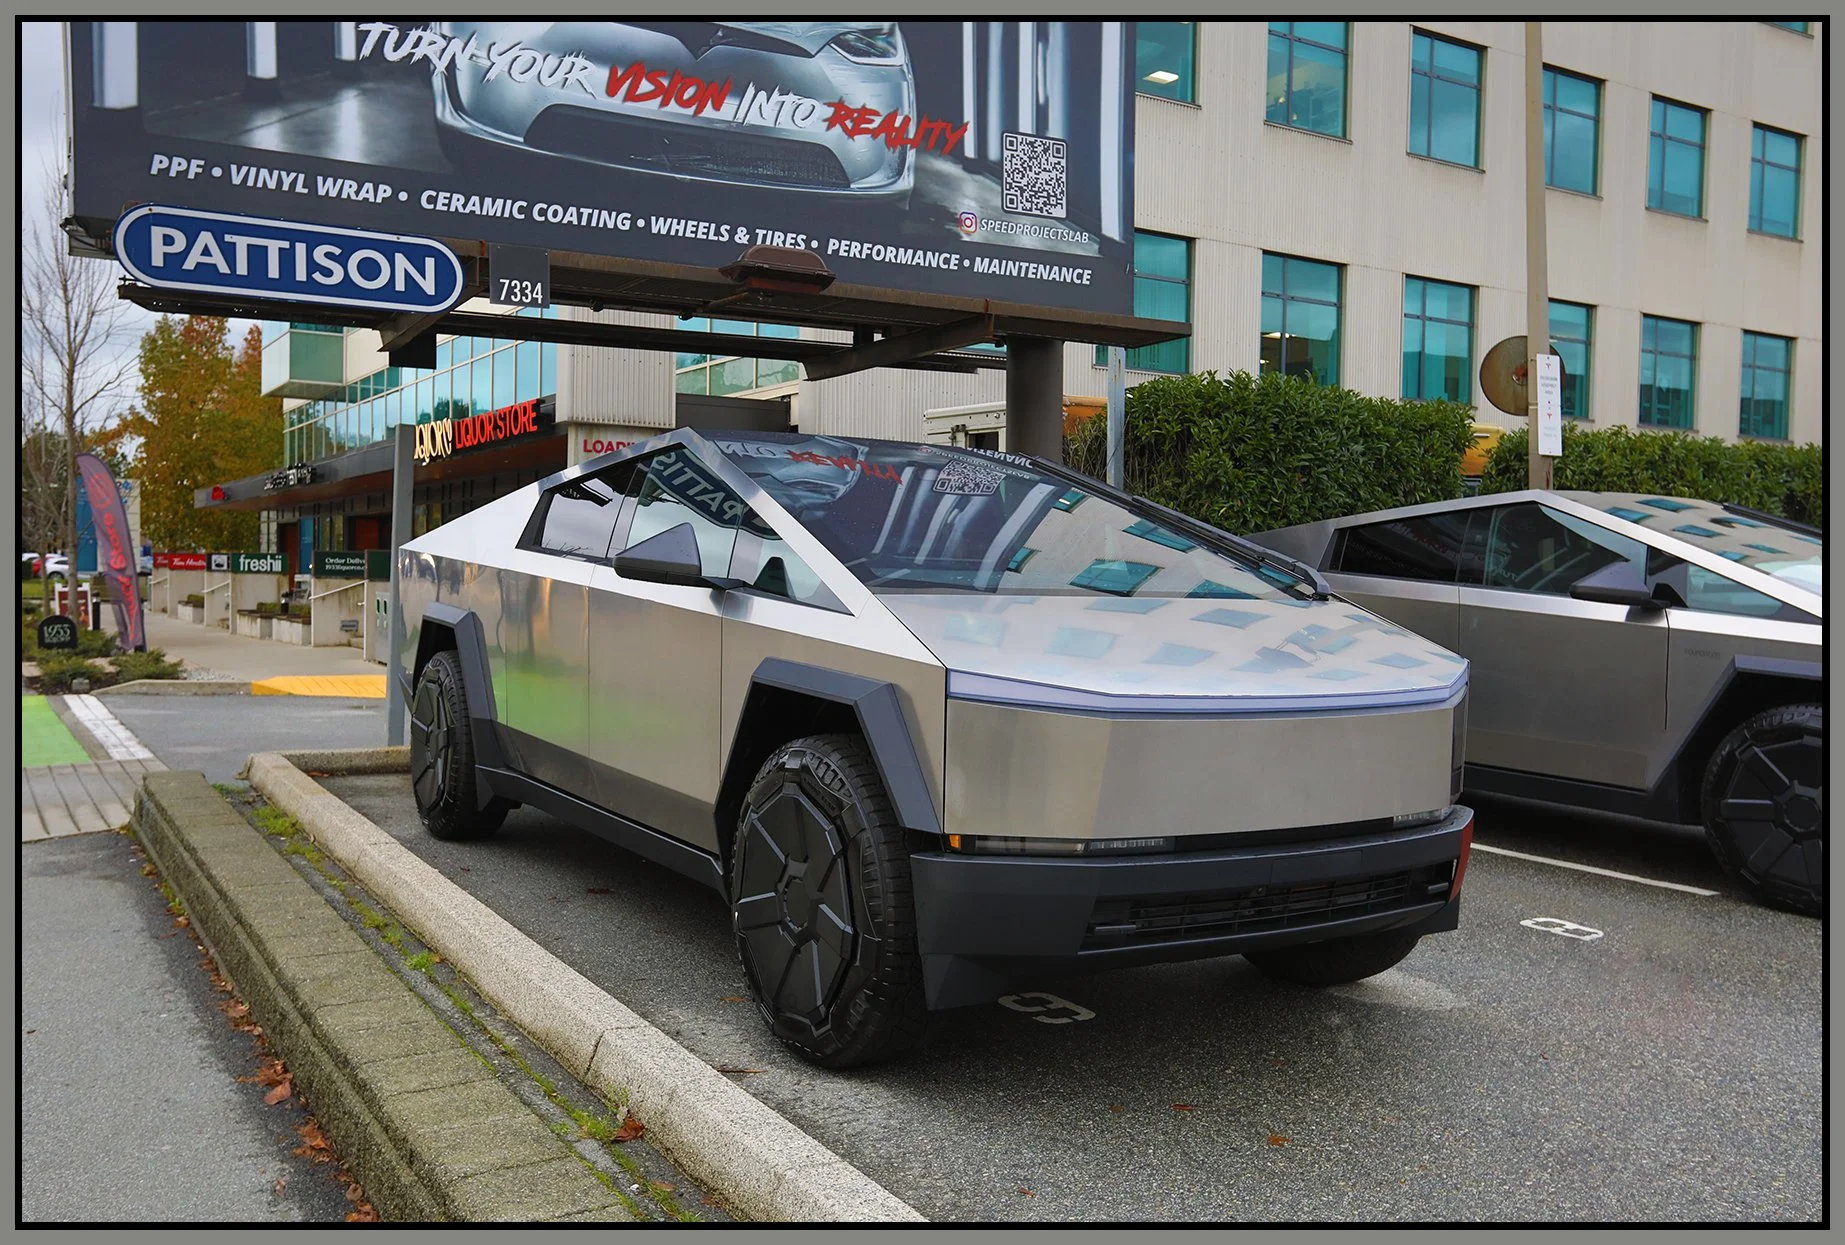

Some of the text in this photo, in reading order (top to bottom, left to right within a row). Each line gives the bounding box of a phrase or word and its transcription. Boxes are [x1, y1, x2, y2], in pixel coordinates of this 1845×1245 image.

[357, 22, 969, 155] TURN YOUR VISION INTO REALITY
[150, 154, 1092, 285] PPF VINYL WRAP CERAMIC COATING WHEELS & TIRES PERFORMANCE MAINTENANCE
[979, 218, 1090, 245] SPEEDPROJECTSLAB
[149, 225, 436, 297] PATTISON
[499, 278, 544, 304] 7334
[453, 410, 495, 450] LIQUOR
[495, 399, 539, 440] STORE
[583, 439, 636, 454] LOAD
[103, 512, 128, 571] Store
[238, 555, 282, 572] freshii
